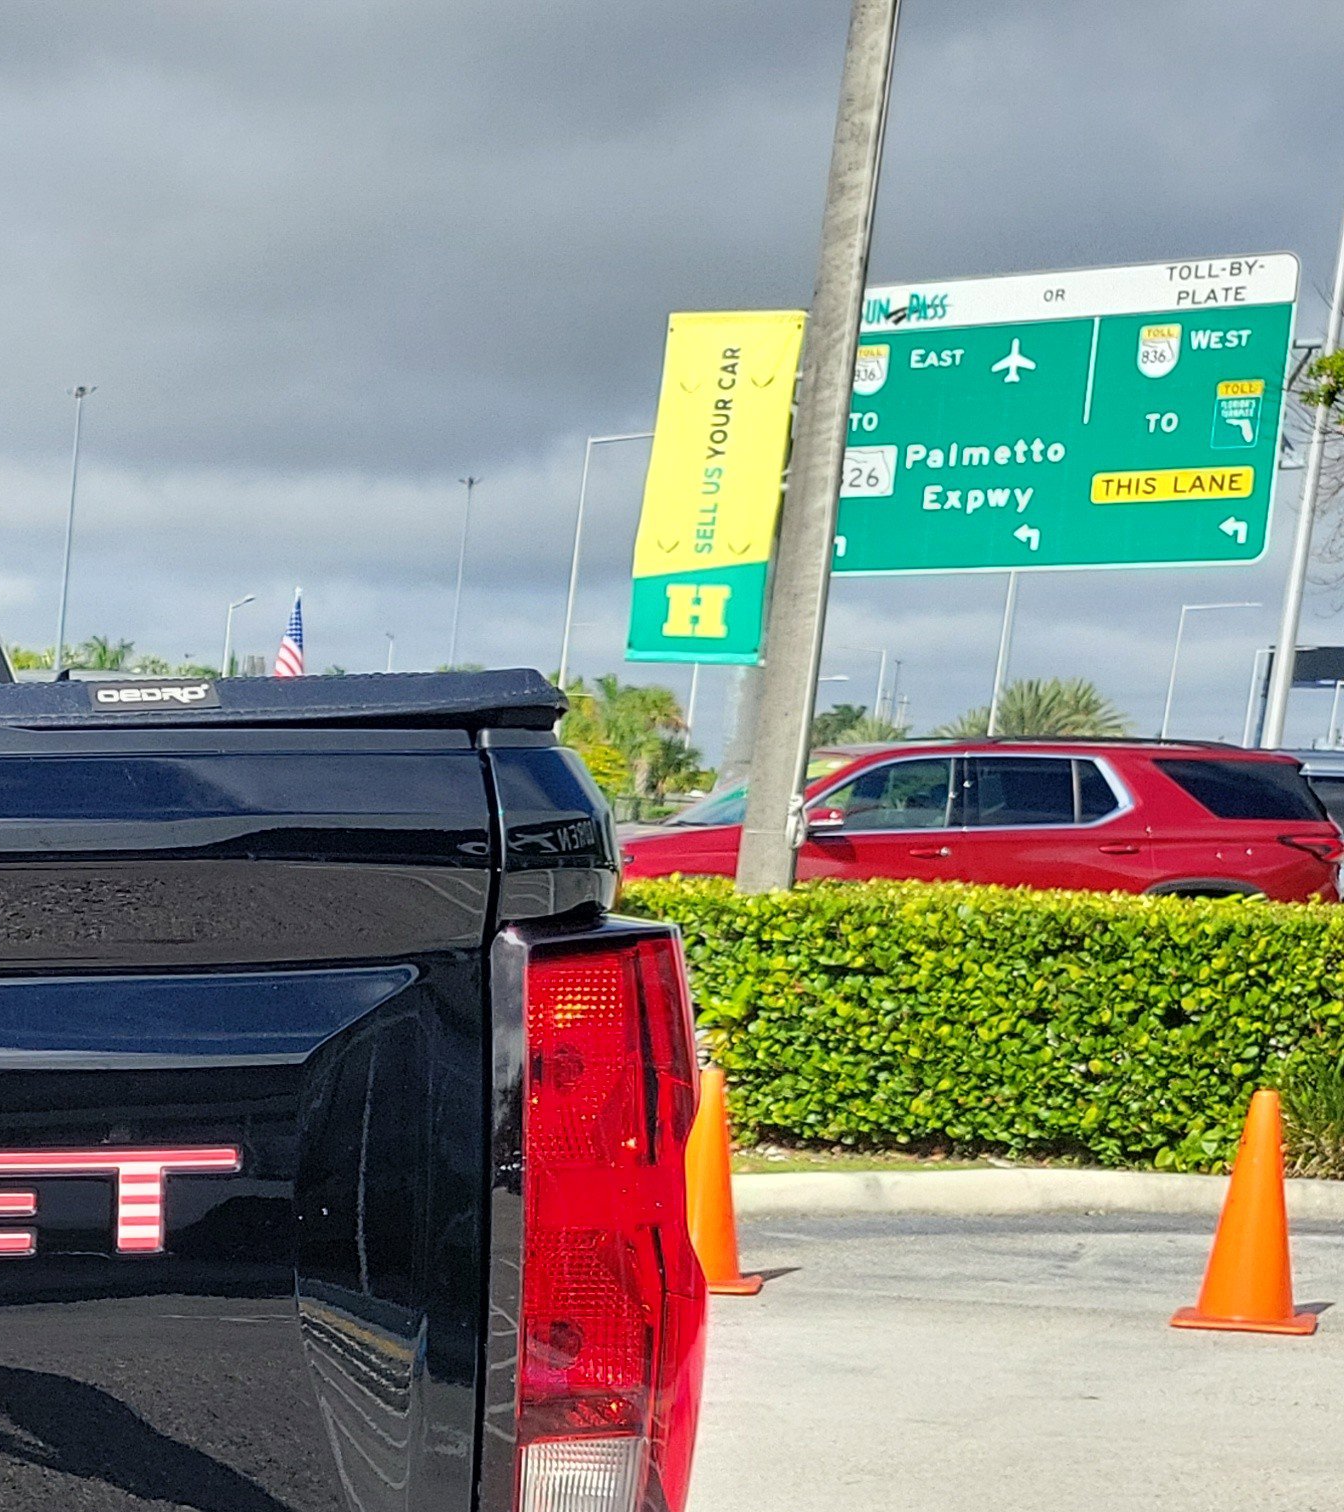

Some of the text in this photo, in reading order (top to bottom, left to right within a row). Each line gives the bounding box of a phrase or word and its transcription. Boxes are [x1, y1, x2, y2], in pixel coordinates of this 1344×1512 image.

[1166, 260, 1265, 281] TOLL-BY-
[1043, 288, 1066, 303] OR
[1176, 286, 1247, 305] PLATE
[1147, 328, 1174, 338] TOLL
[1190, 329, 1252, 350] WEST
[910, 348, 965, 369] EAST
[1141, 350, 1167, 364] 836
[1223, 382, 1255, 395] TOLL
[848, 411, 878, 432] TO
[1145, 412, 1178, 433] TO
[695, 347, 741, 554] SELL US YOUR CAR
[905, 437, 1066, 469] Palmetto
[841, 467, 879, 488] 26
[1101, 473, 1243, 496] THIS LANE
[922, 485, 1034, 515] Expwy
[662, 583, 731, 637] H
